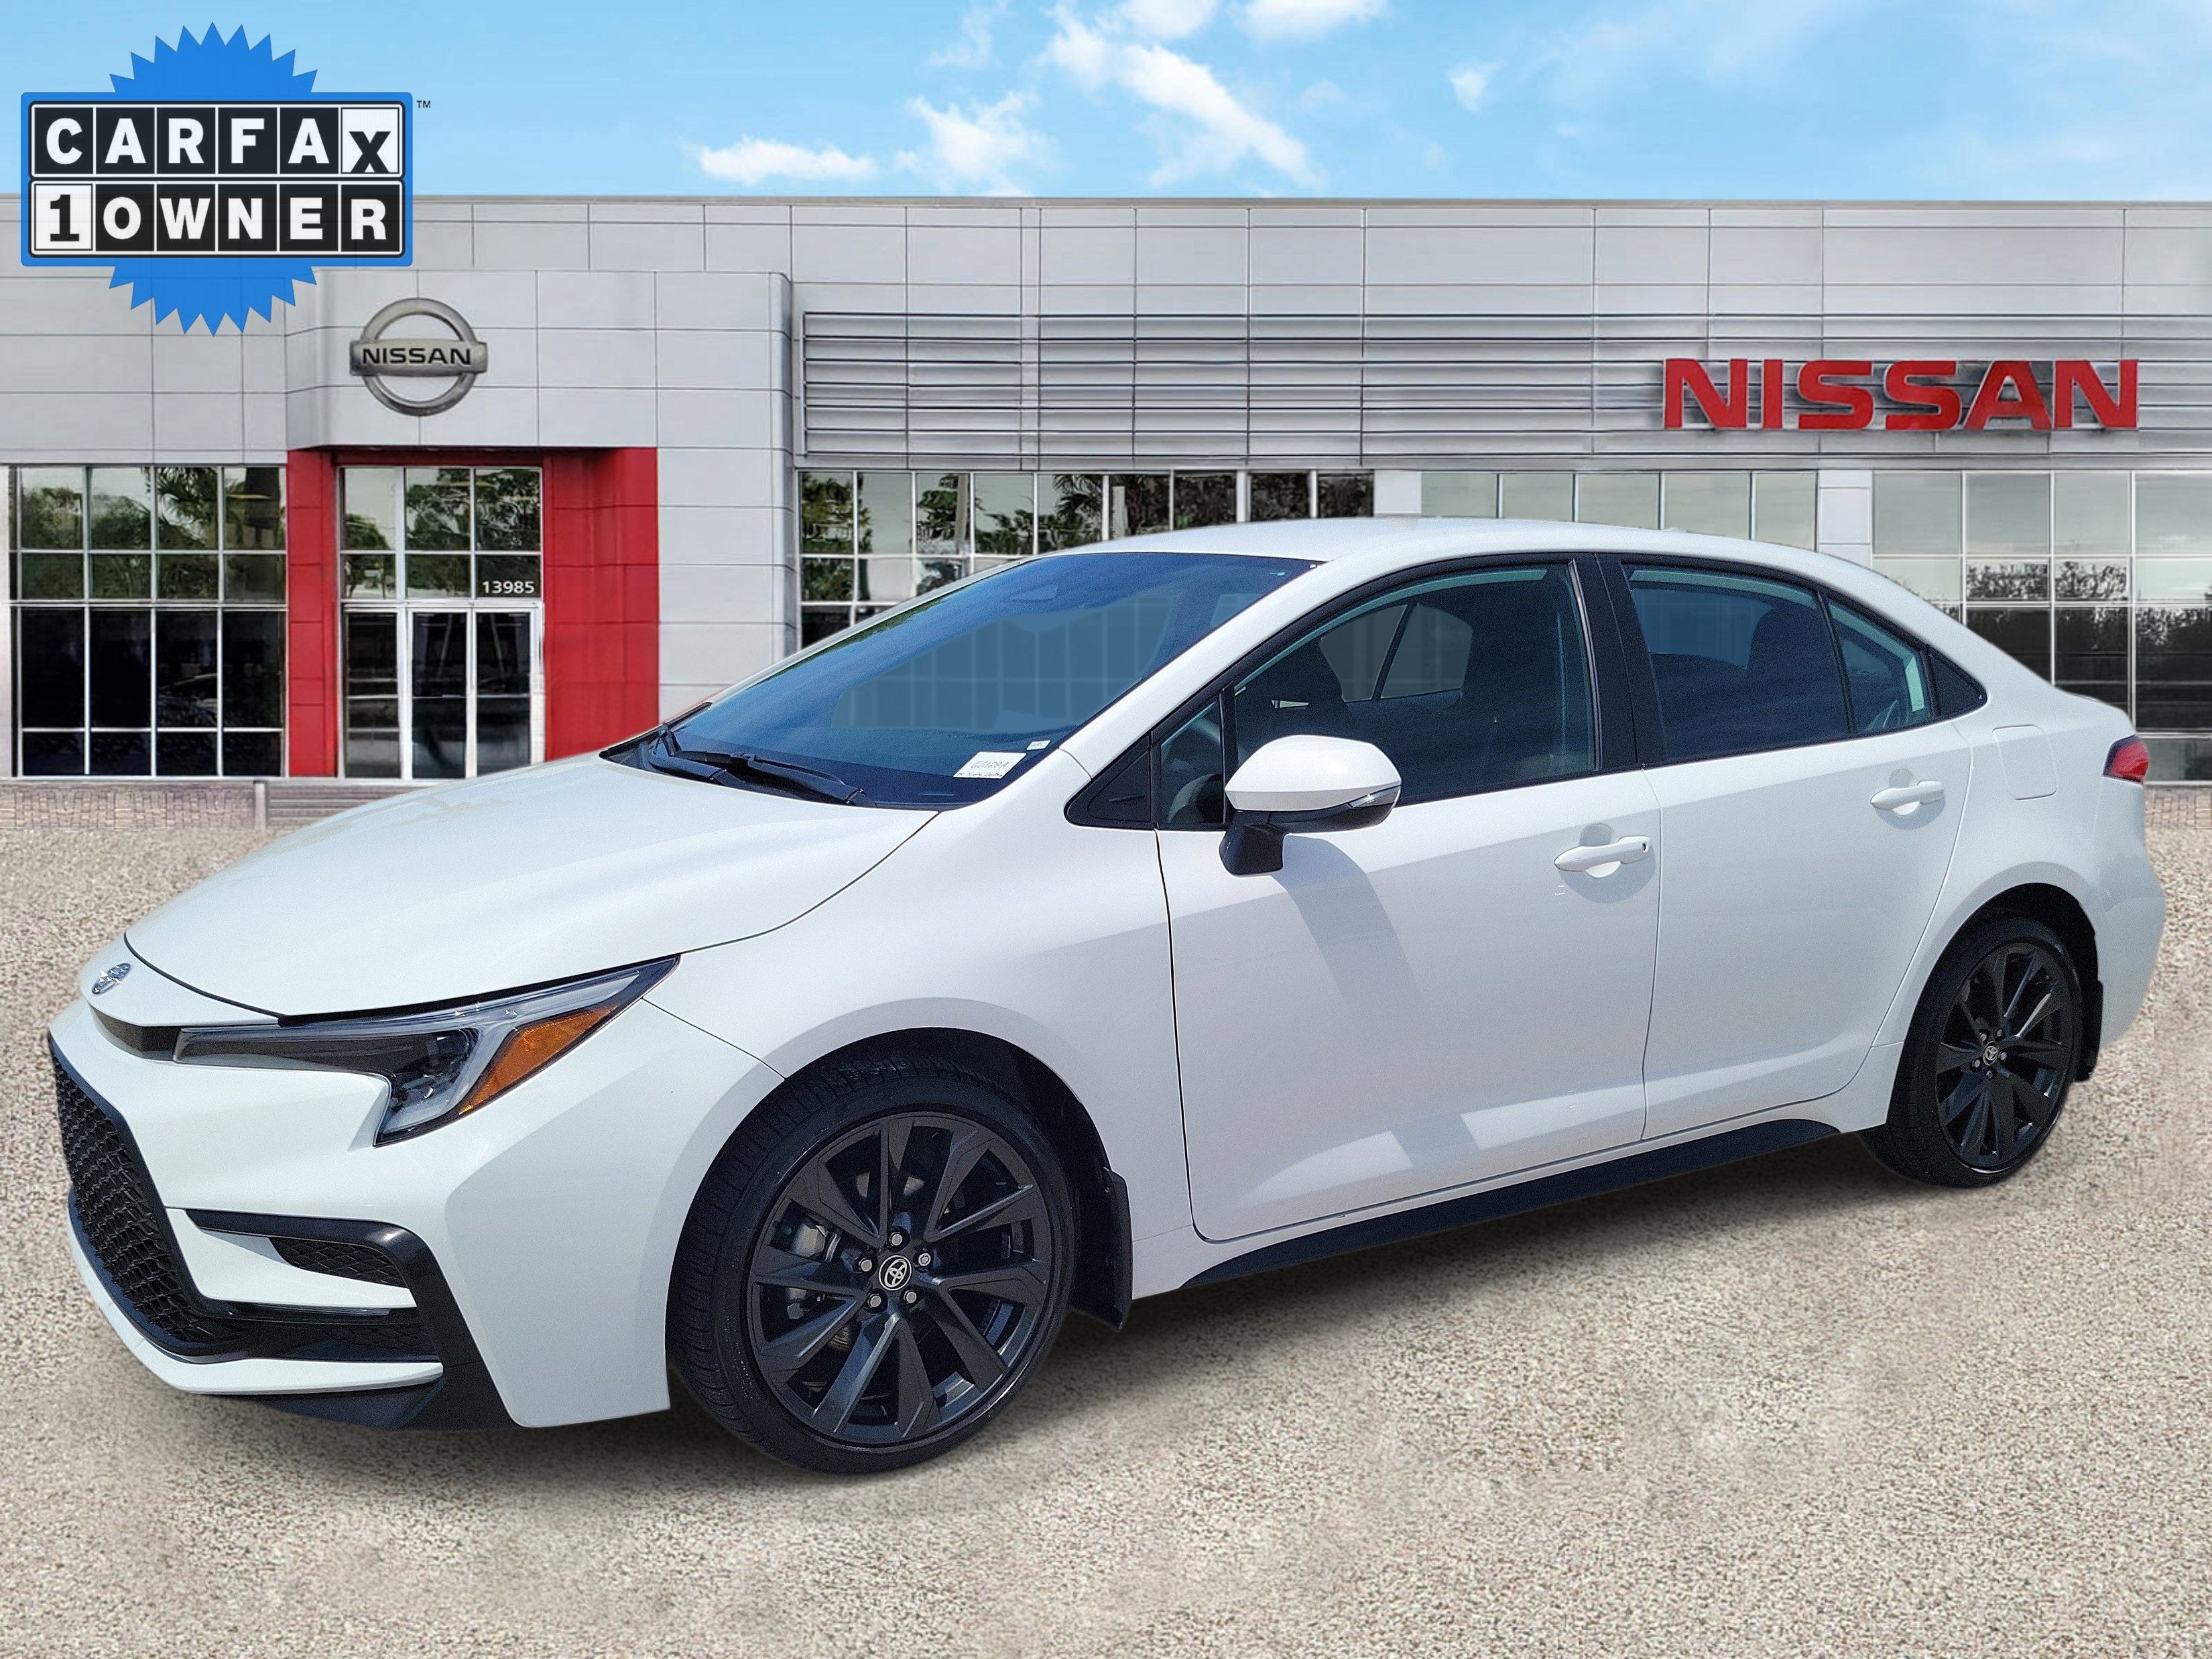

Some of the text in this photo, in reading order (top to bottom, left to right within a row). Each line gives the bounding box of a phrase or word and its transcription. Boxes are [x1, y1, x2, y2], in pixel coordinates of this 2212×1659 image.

[363, 347, 471, 365] NISSAN
[1663, 358, 2139, 431] NISSAN
[482, 580, 535, 594] 13985
